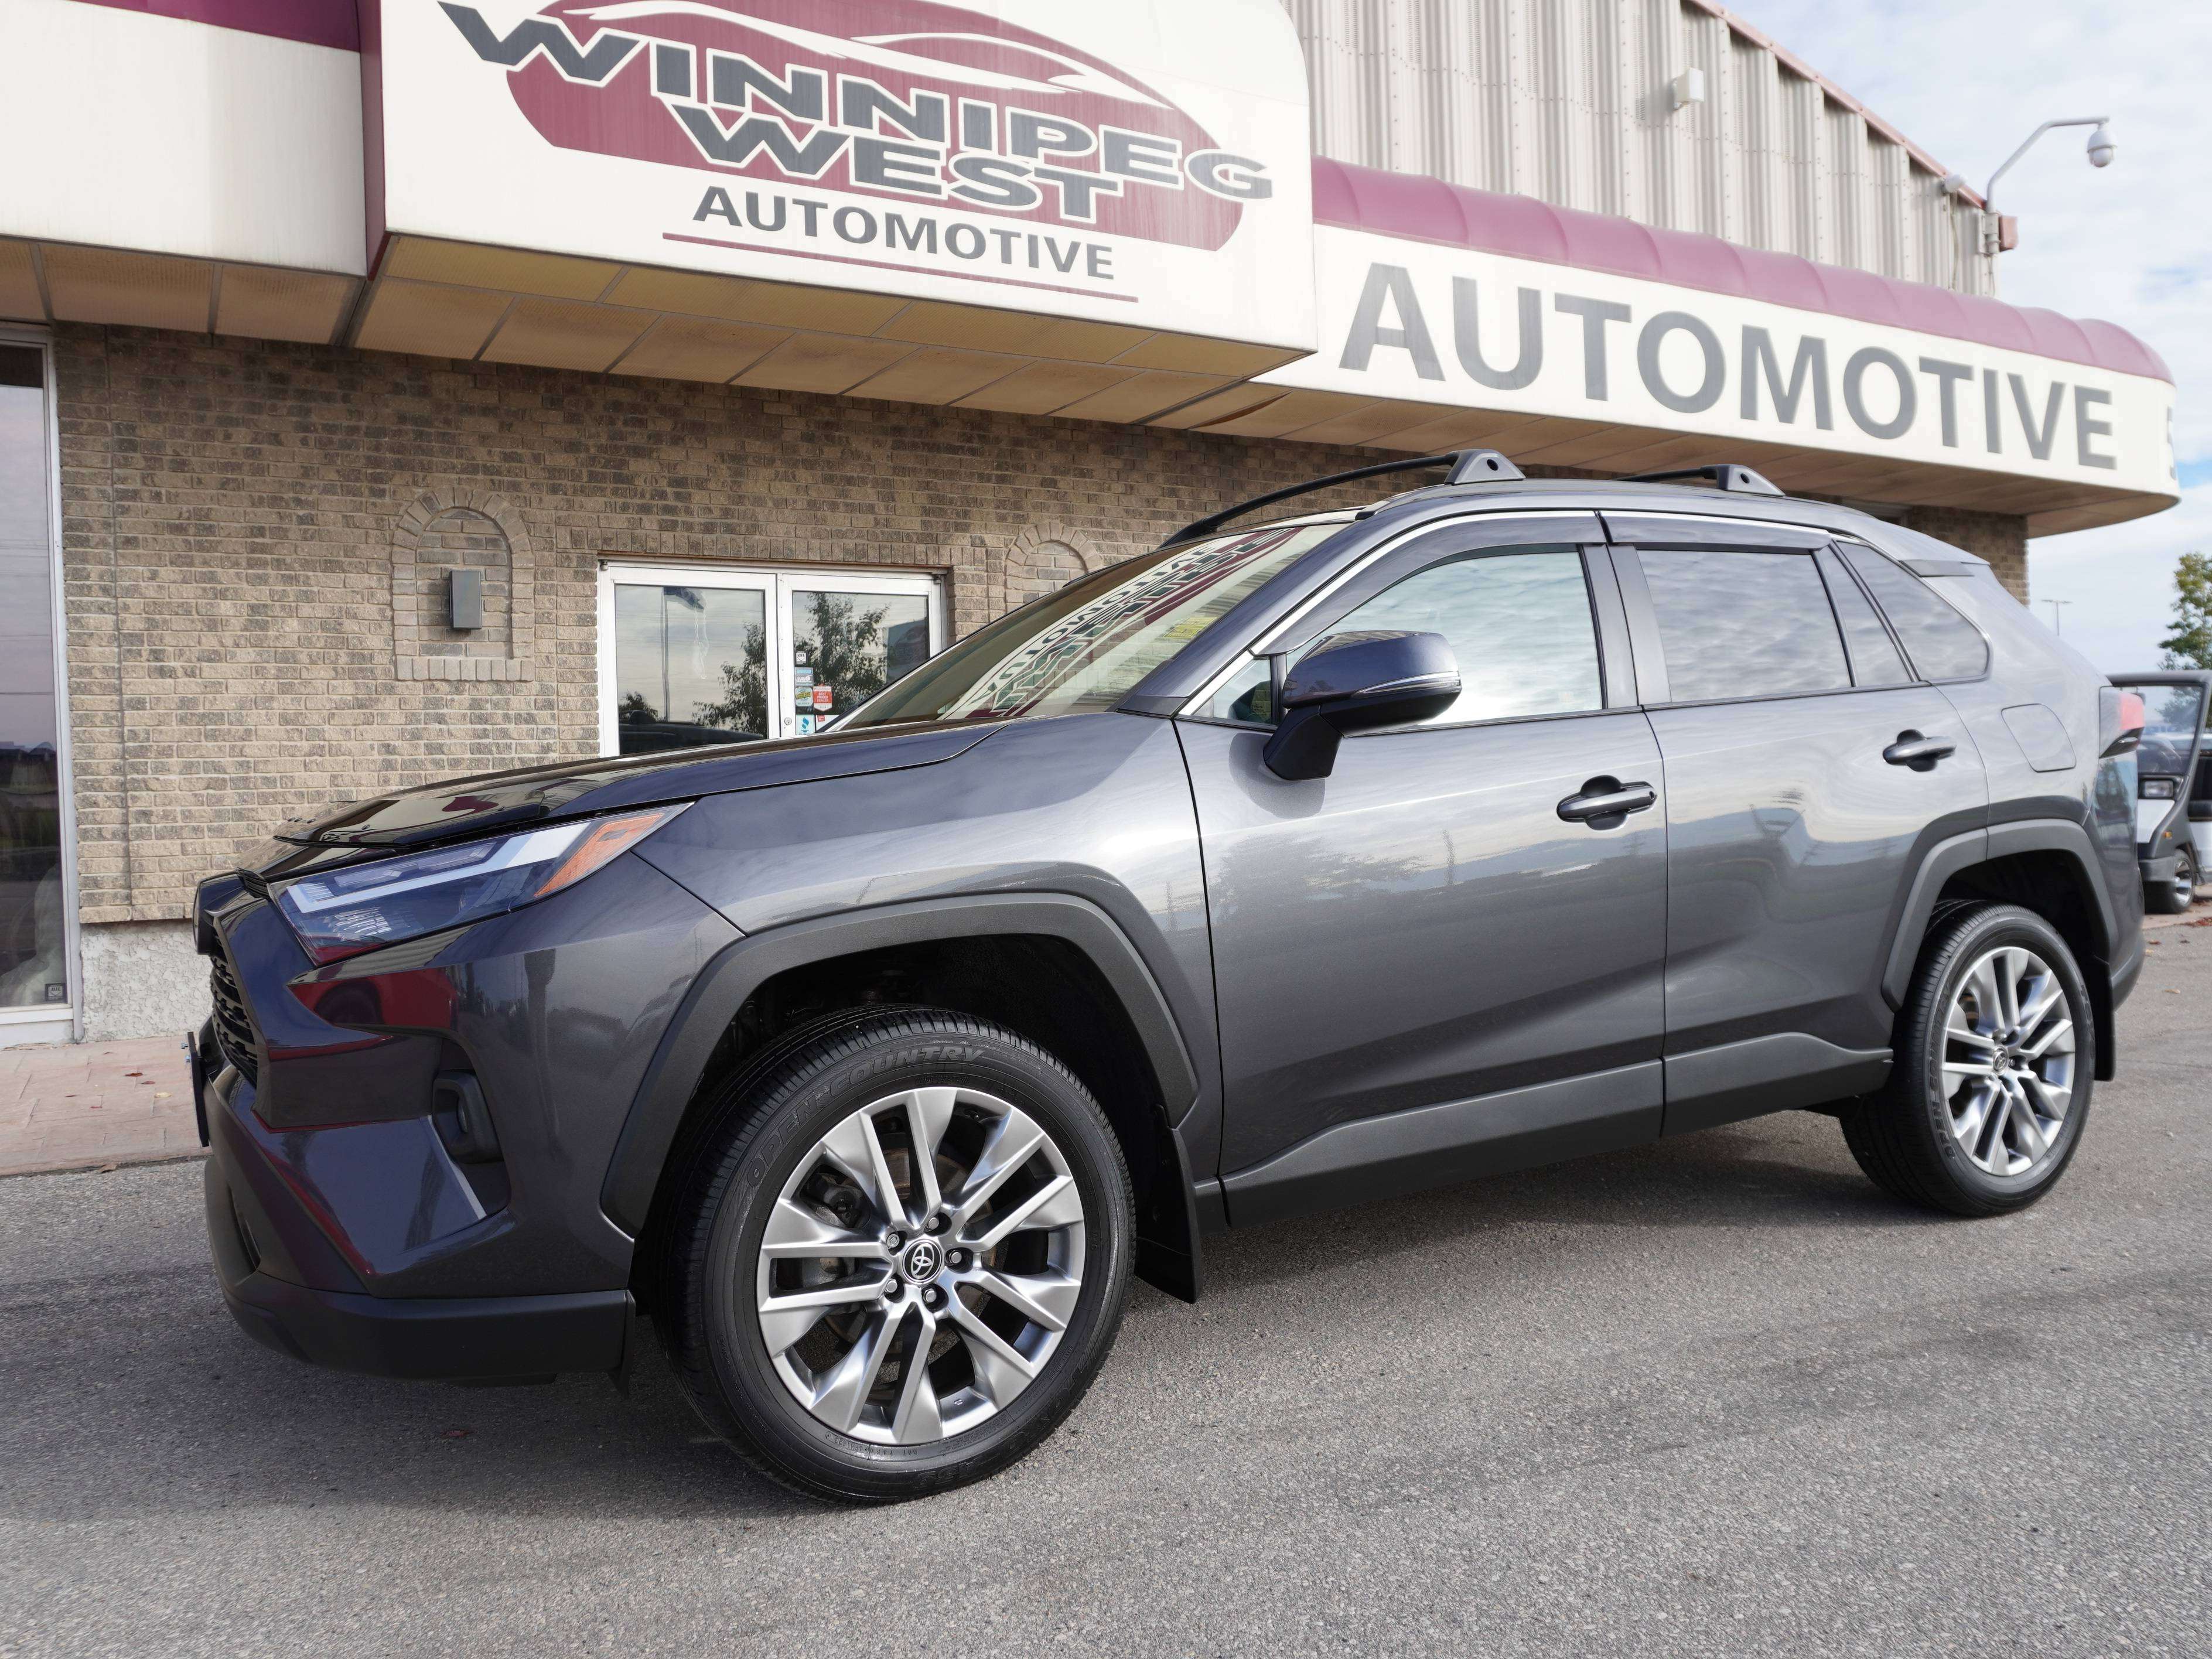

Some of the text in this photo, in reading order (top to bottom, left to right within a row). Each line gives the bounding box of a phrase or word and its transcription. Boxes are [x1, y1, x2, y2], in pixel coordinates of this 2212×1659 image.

[436, 0, 1273, 199] WINNIPEG
[671, 103, 1119, 219] WEST
[693, 186, 1114, 280] AUTOMOTIVE
[1339, 262, 2117, 470] AUTOMOTIVE
[747, 1045, 985, 1188] OPEN COUNTRY
